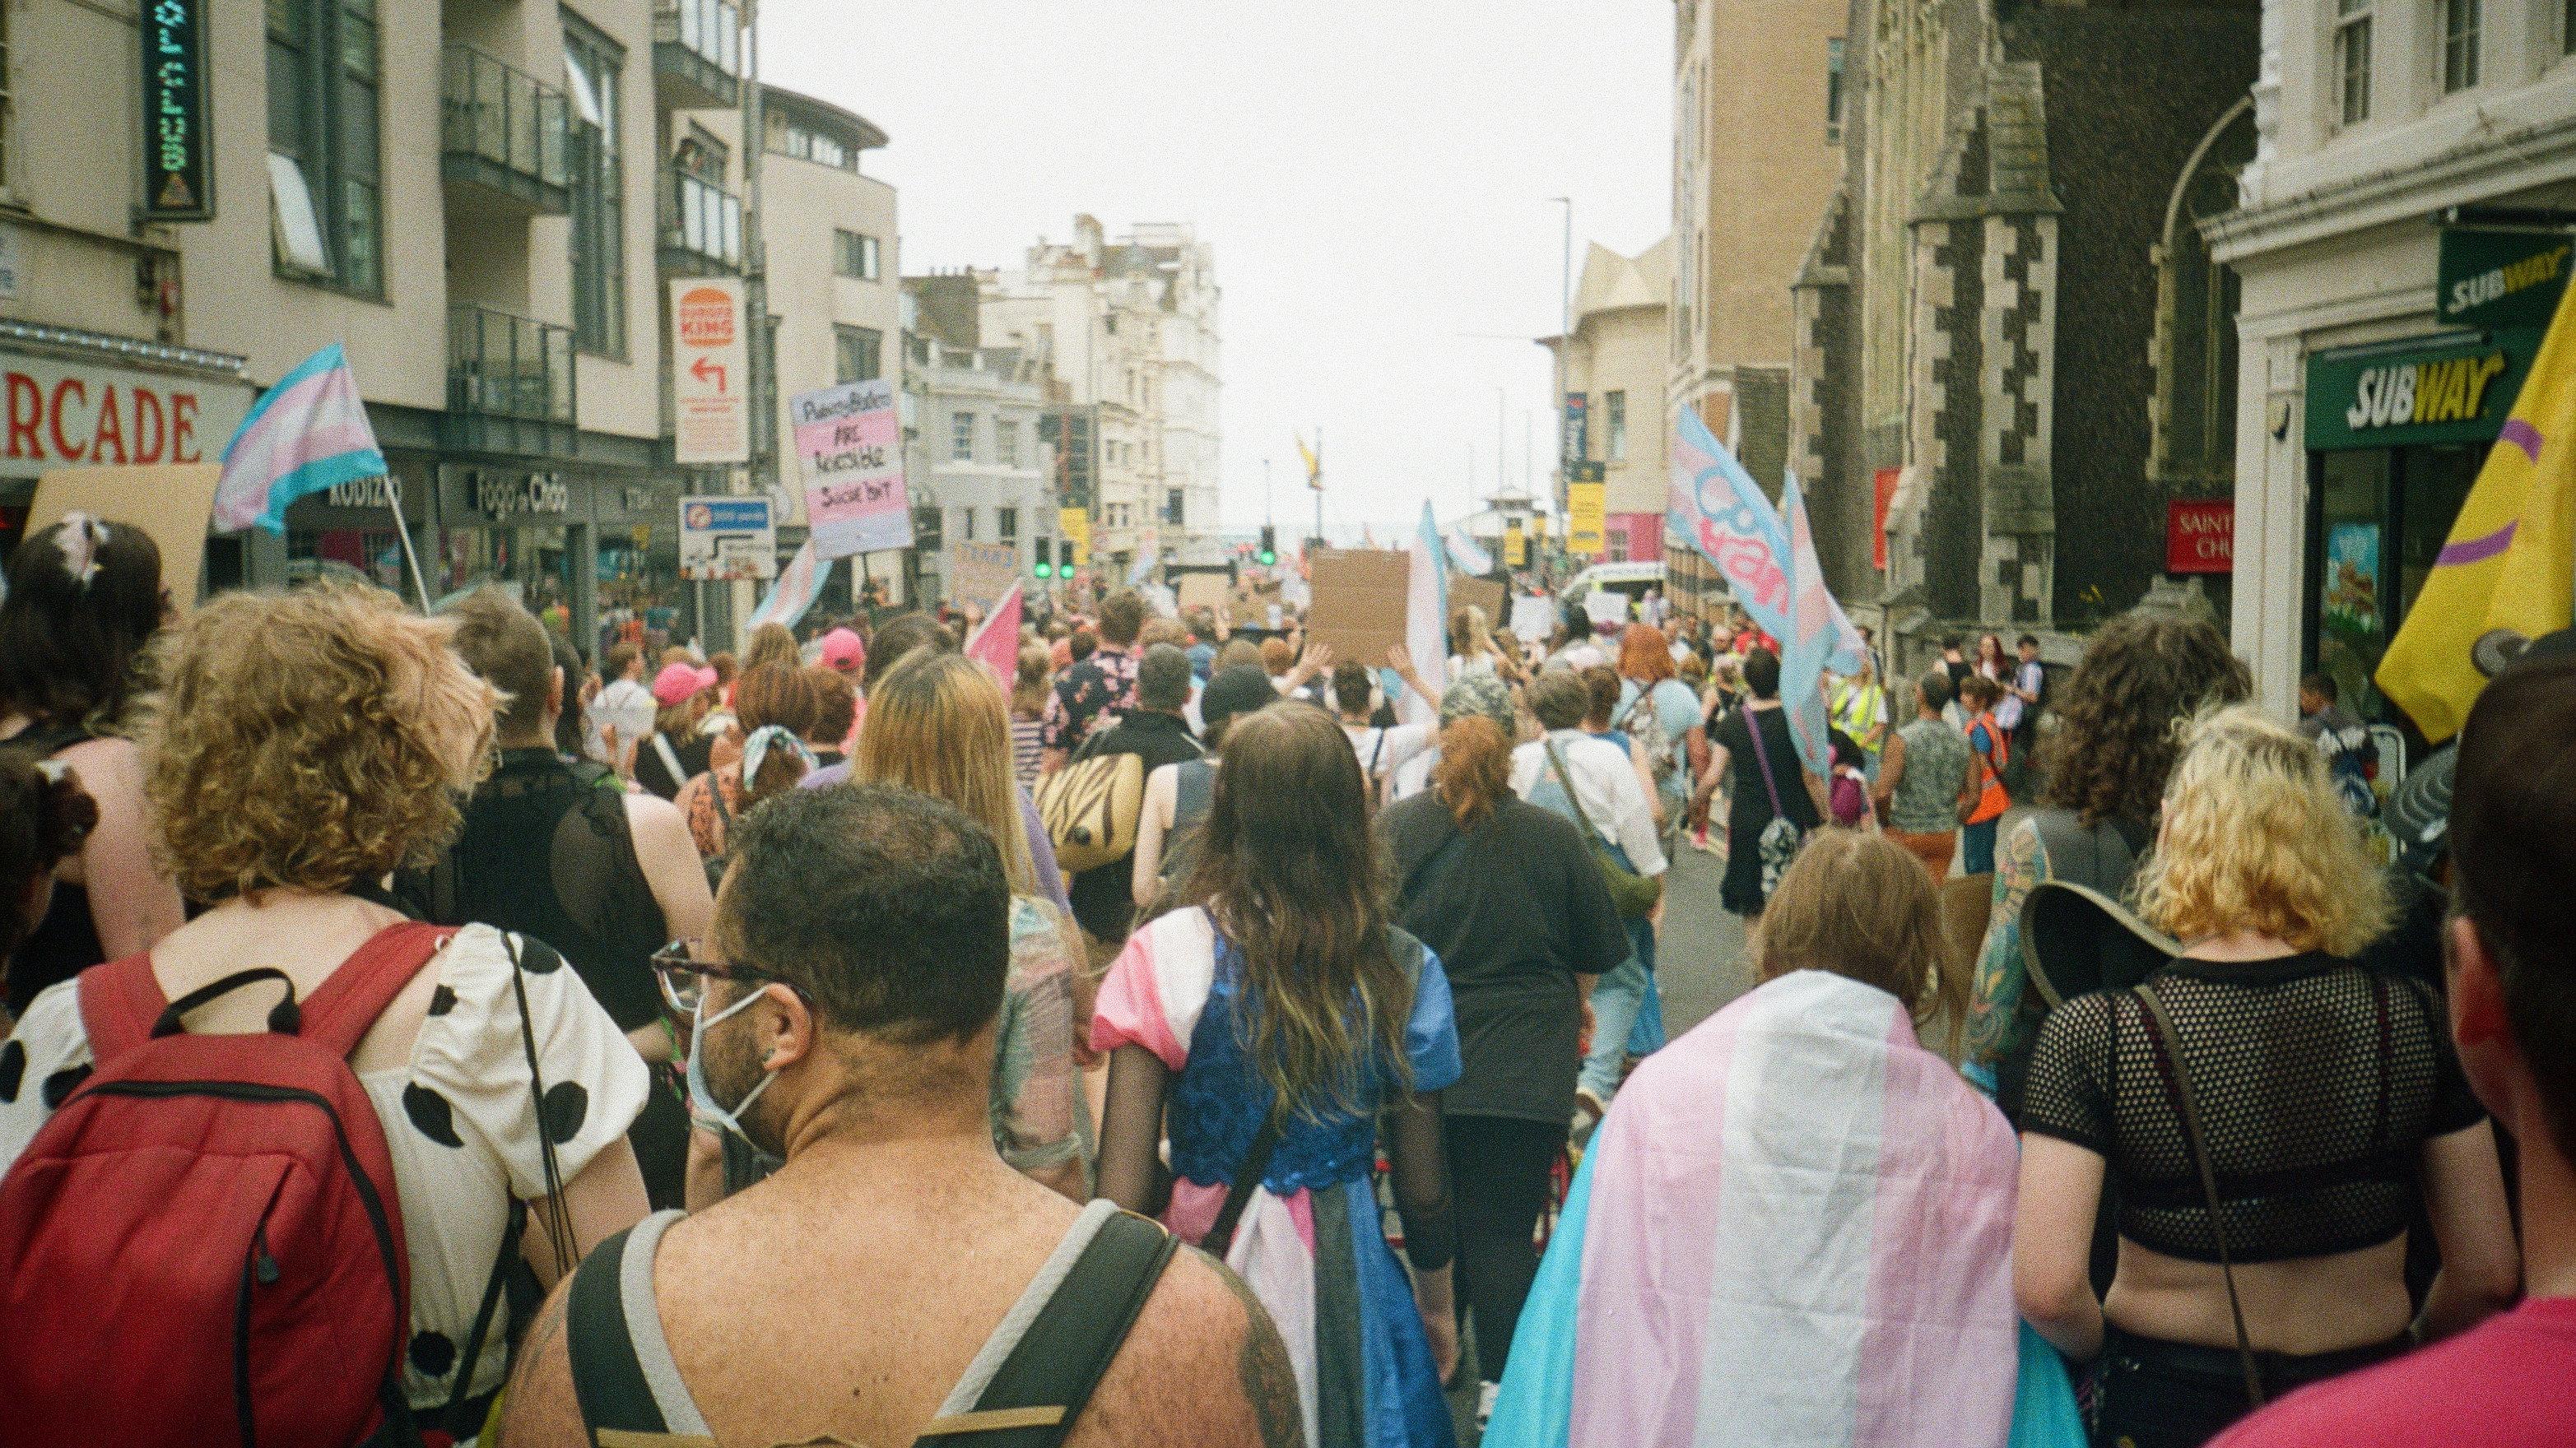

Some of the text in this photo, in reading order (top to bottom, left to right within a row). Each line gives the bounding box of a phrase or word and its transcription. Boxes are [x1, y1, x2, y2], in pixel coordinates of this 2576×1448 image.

[2447, 245, 2570, 314] SUBWAY
[681, 320, 734, 336] KING
[2346, 349, 2506, 430] SUBWAY
[2, 371, 202, 464] RCADE
[2179, 512, 2232, 534] SAINT
[2195, 536, 2233, 559] CHU
